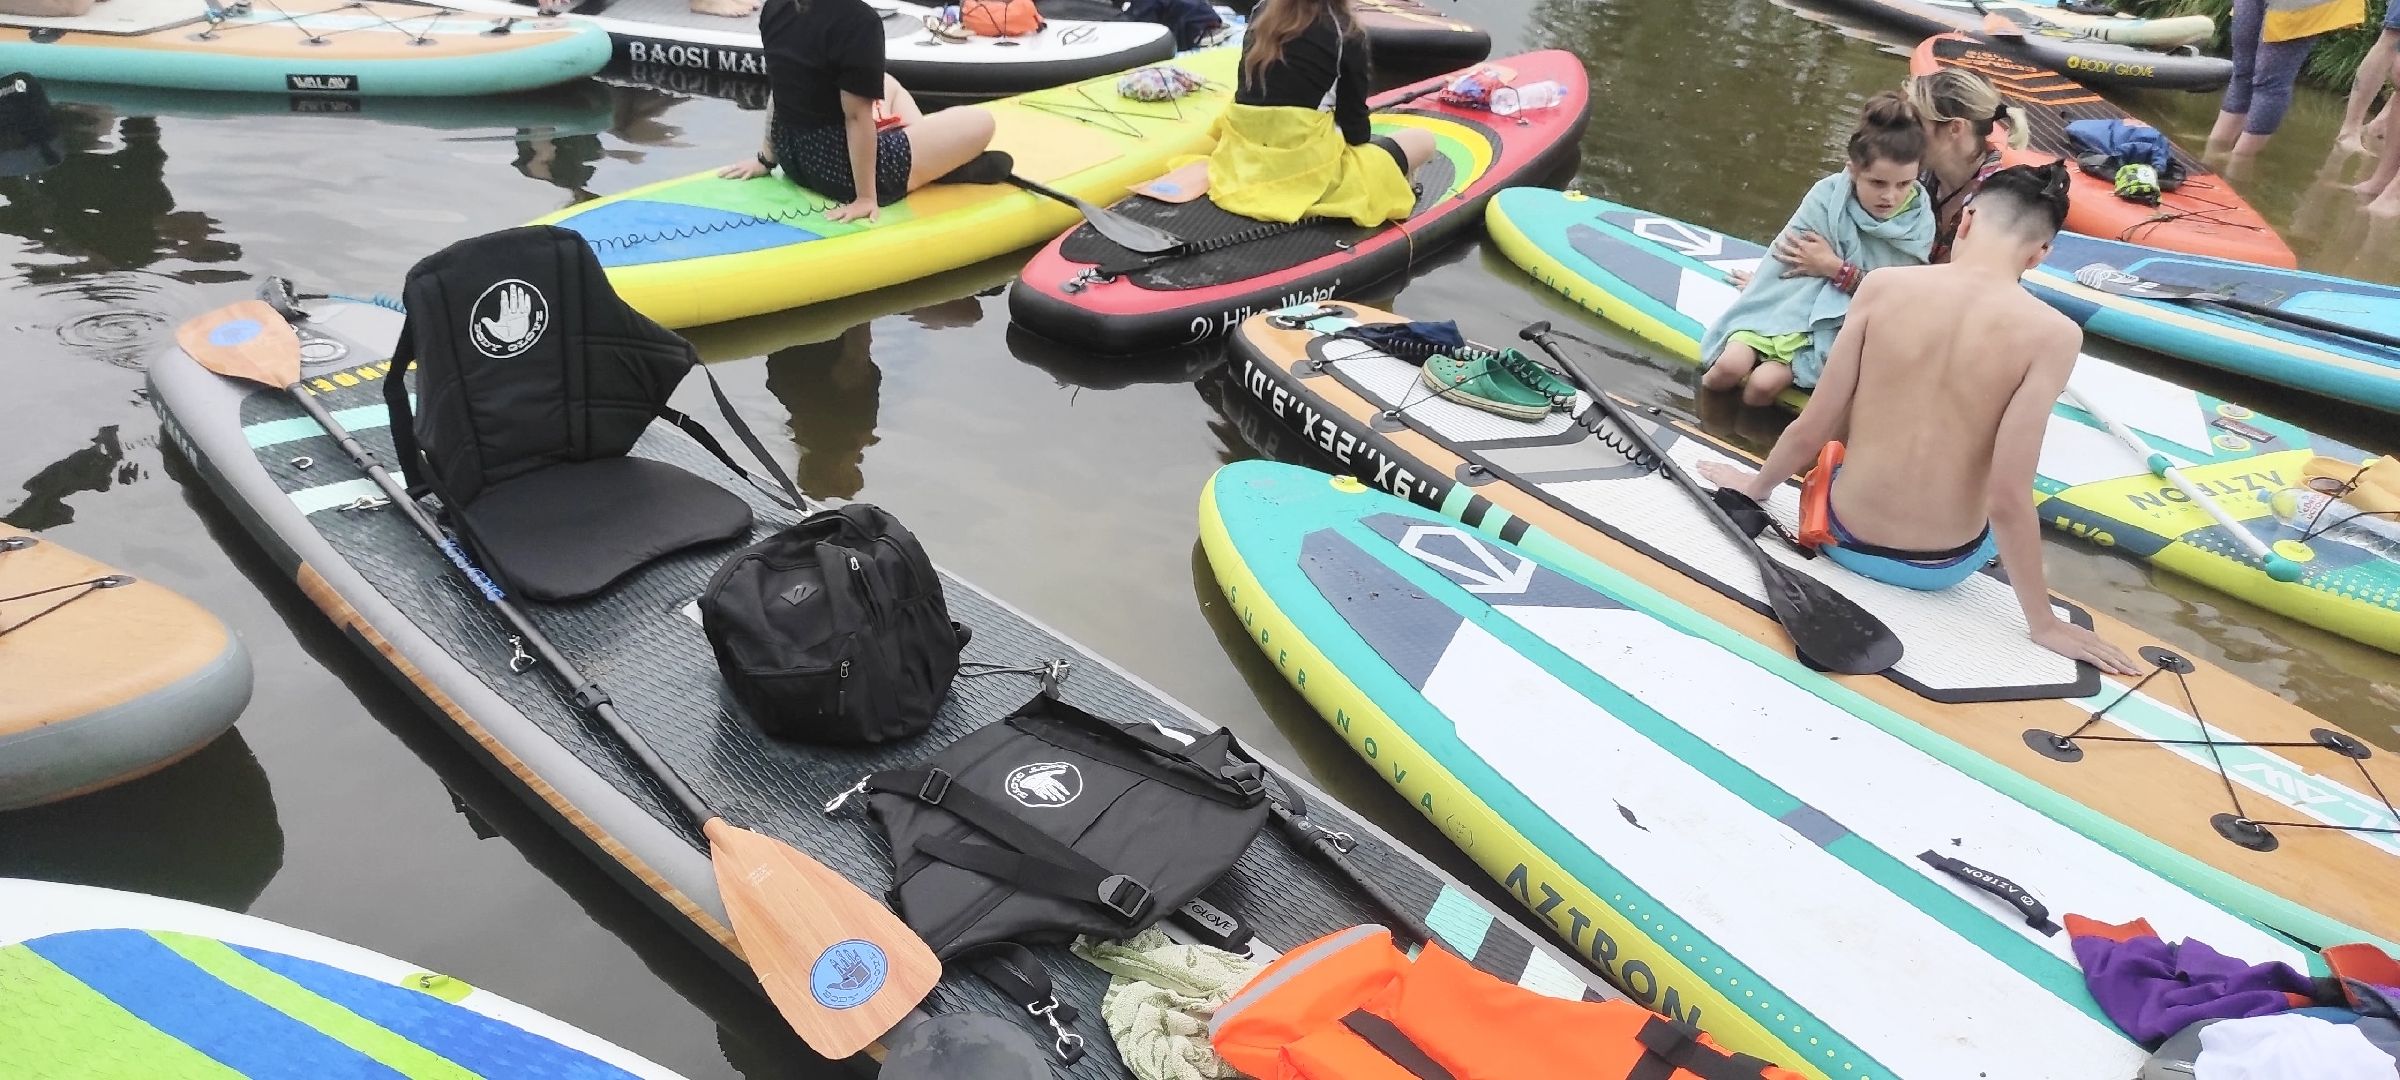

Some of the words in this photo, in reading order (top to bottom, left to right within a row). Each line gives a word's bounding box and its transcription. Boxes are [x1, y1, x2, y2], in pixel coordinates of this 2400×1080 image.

[630, 40, 711, 69] BAOSI
[1230, 585, 1307, 690] SUPER
[1336, 708, 1435, 816] NOVA
[1961, 866, 2020, 894] AZTRON
[1191, 904, 1233, 931] GLOVE
